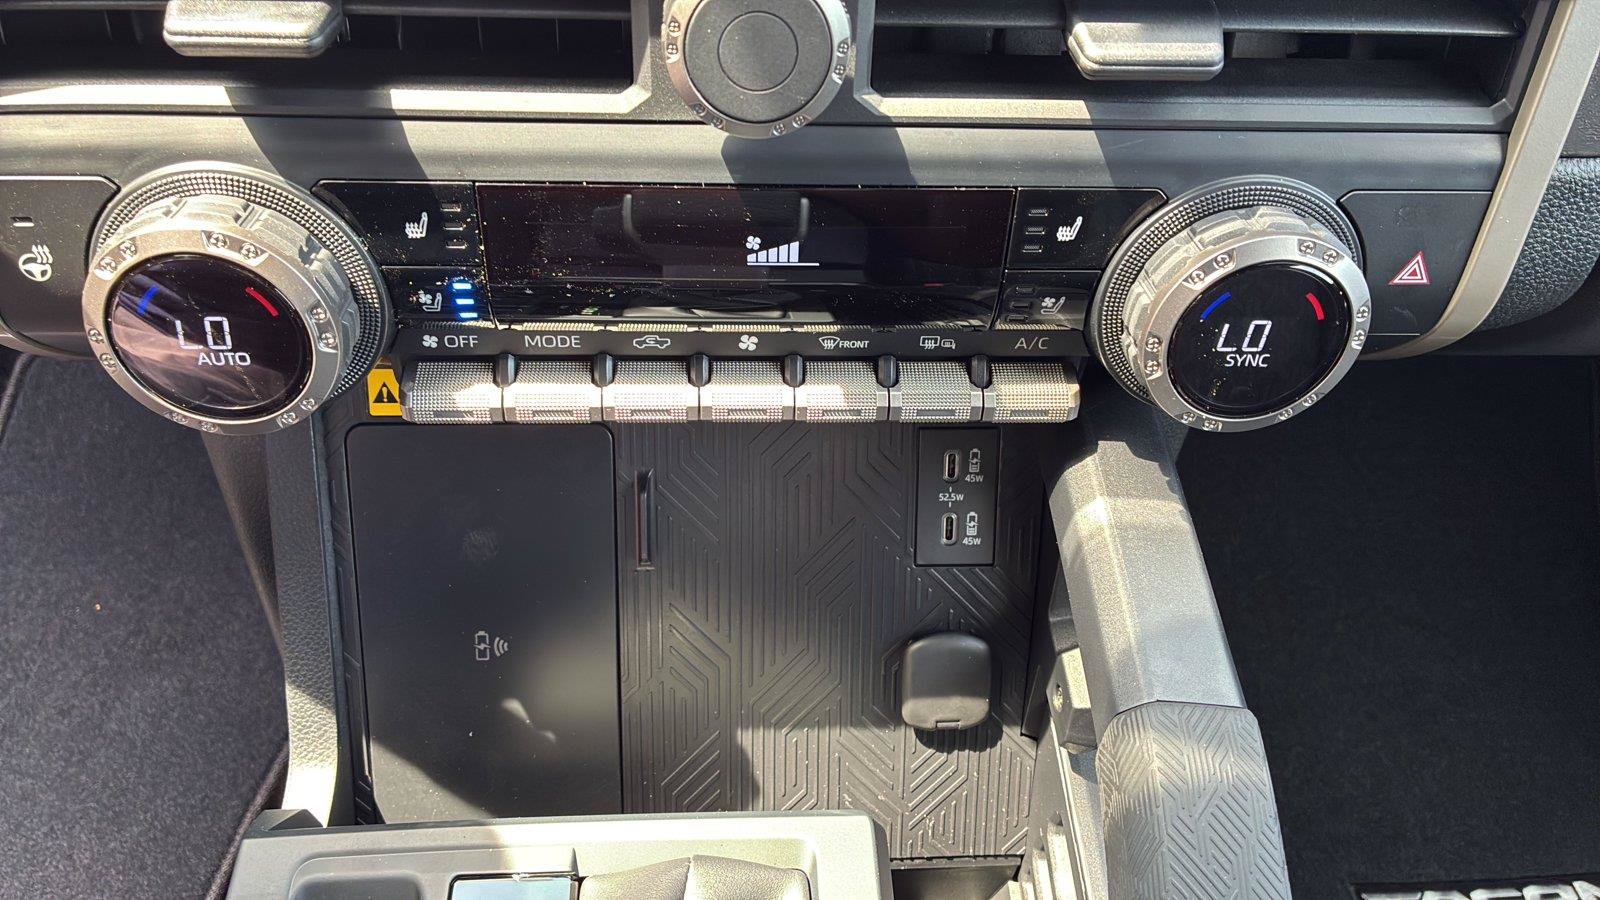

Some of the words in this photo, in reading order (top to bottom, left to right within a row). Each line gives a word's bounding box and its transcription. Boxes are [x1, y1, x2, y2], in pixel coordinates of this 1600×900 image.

[444, 335, 479, 348] OFF
[525, 335, 581, 348] MODE
[838, 340, 869, 349] FRONT
[1015, 337, 1050, 350] A/C
[198, 351, 251, 366] AUTO
[1224, 354, 1271, 367] SYNC
[965, 474, 984, 483] 45W
[938, 493, 964, 502] 52.5W
[962, 538, 981, 547] 45W
